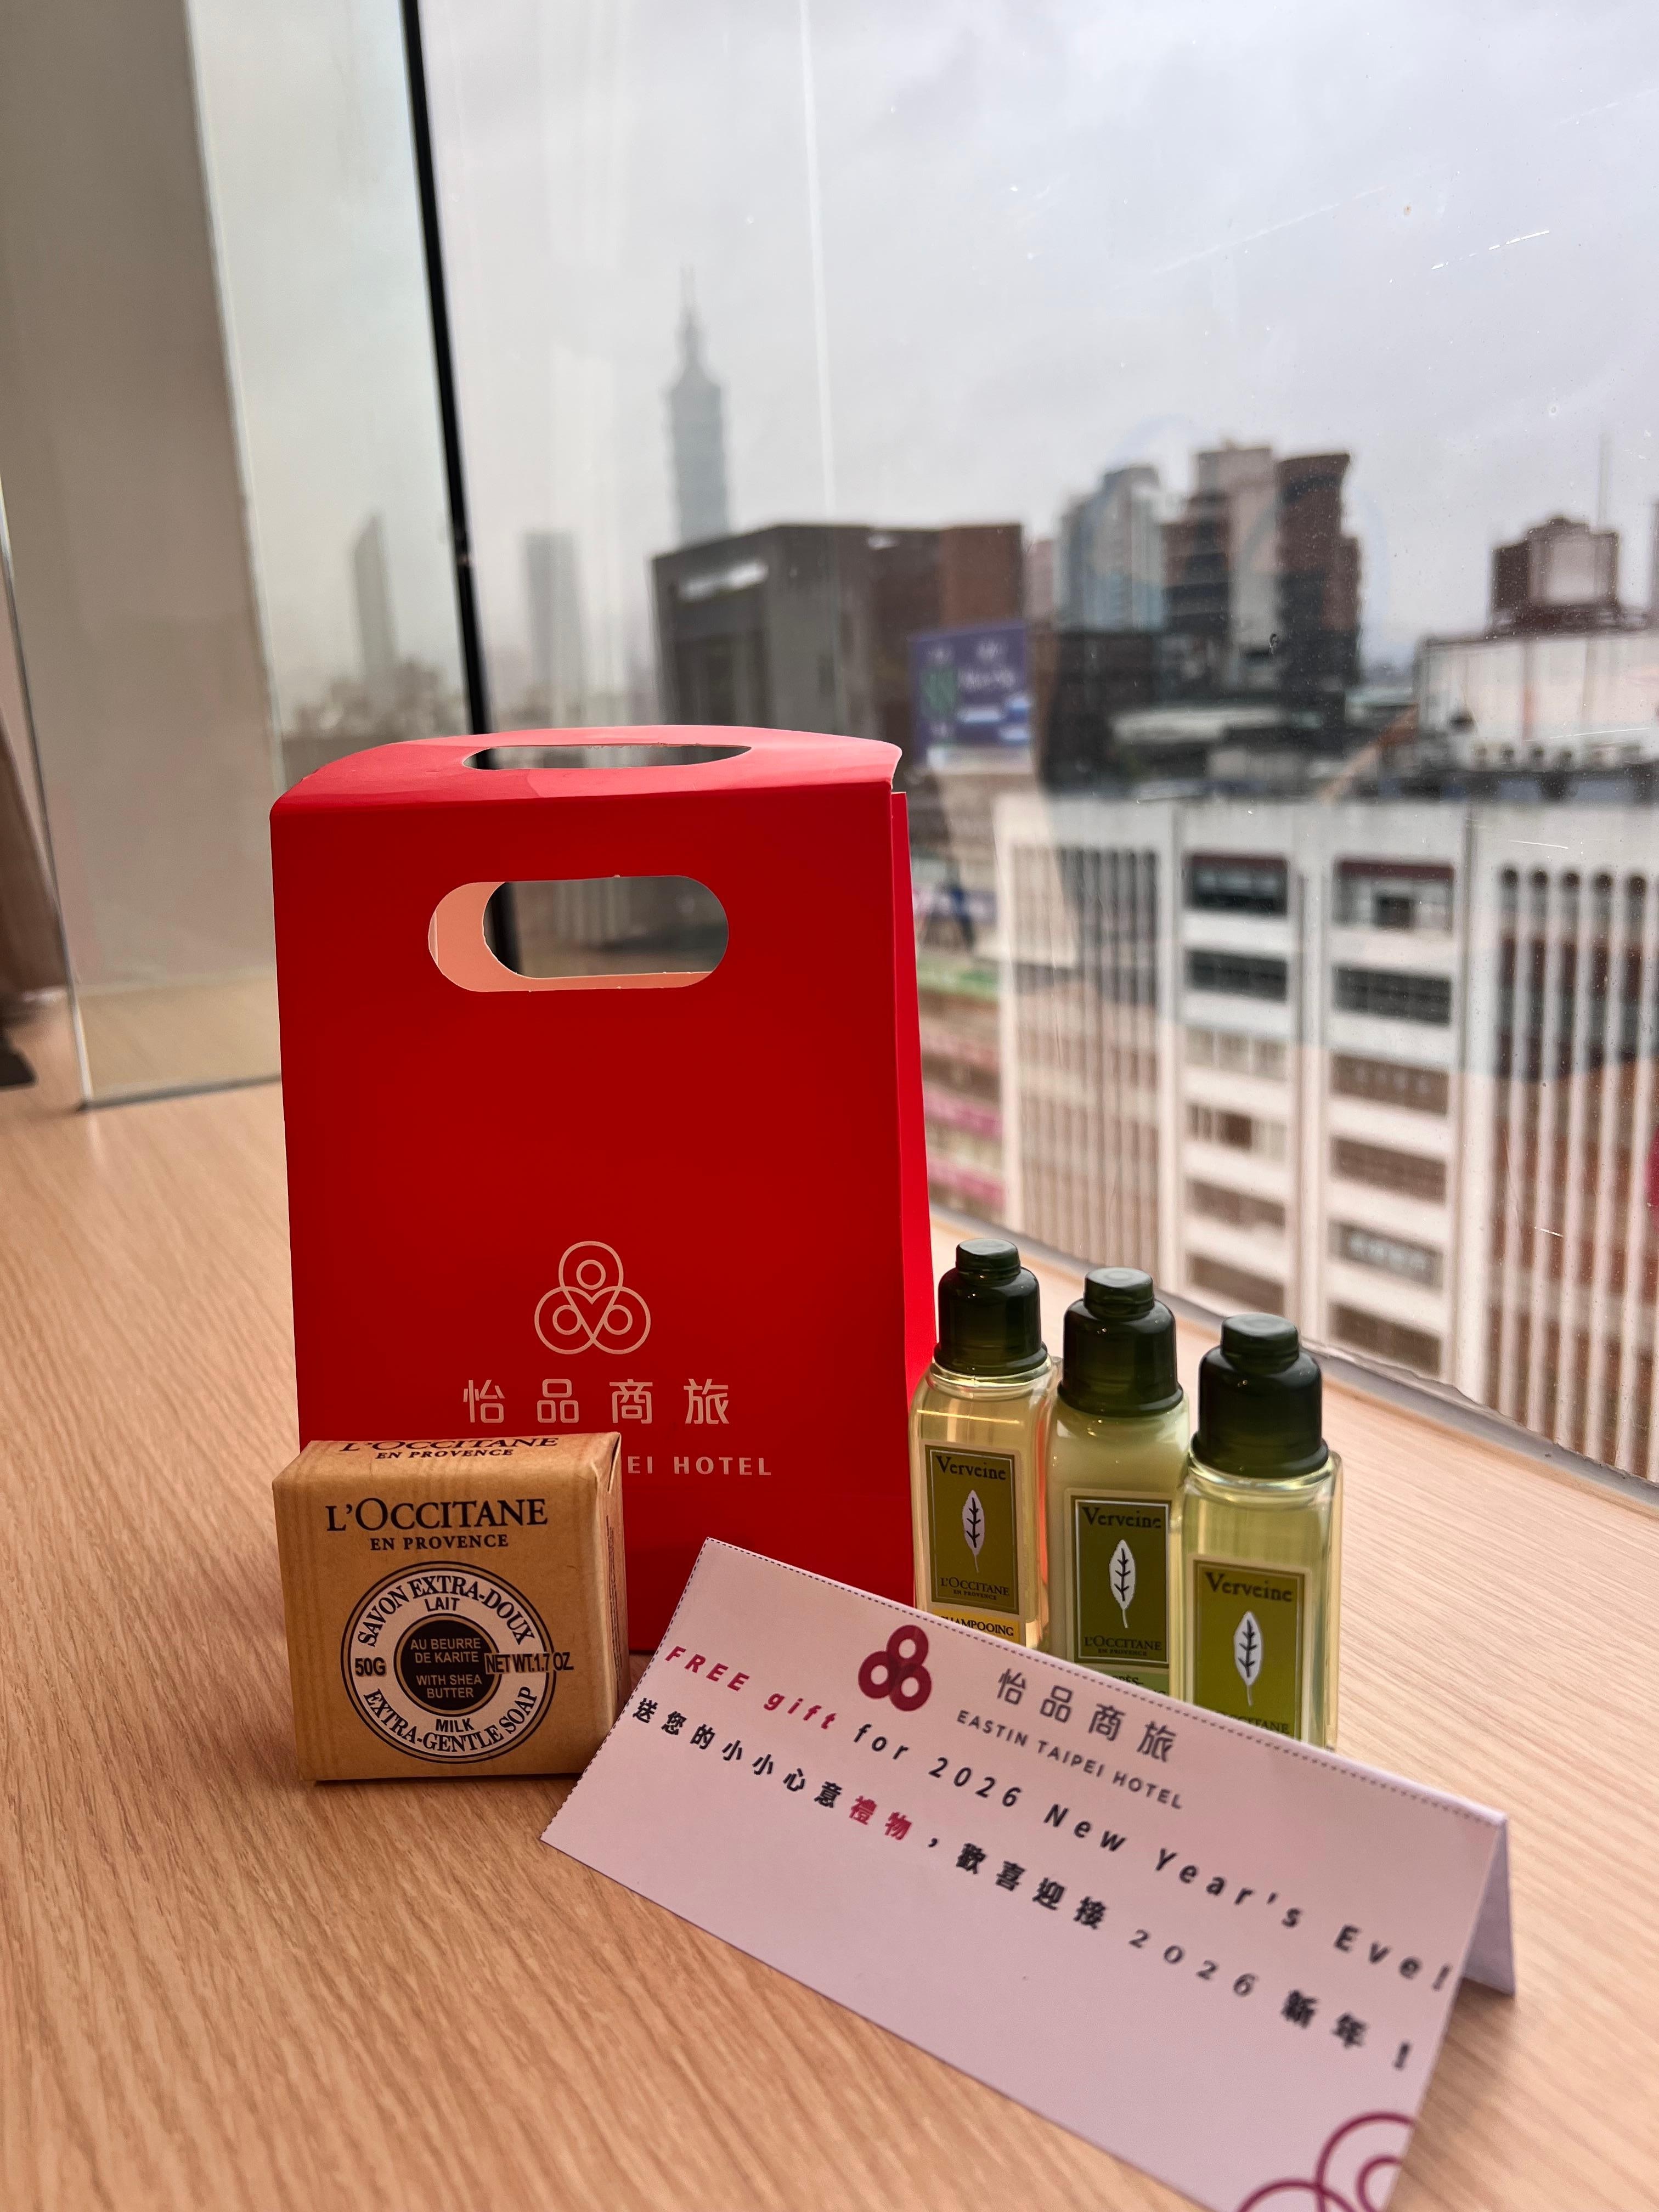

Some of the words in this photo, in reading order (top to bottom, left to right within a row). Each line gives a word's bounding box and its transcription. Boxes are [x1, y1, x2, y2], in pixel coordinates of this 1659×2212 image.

[463, 1378, 729, 1425] 怡品商旅
[408, 1449, 514, 1459] PROVENCE
[674, 1456, 771, 1476] HOTEL
[935, 1455, 1007, 1481] Verveine
[325, 1497, 548, 1532] L'OCCITANE
[1081, 1506, 1162, 1529] Verveine
[370, 1537, 395, 1551] EN
[403, 1534, 509, 1550] PROVENCE
[940, 1577, 1010, 1596] L'OCCITANE
[964, 1590, 997, 1601] PROVENCE
[1205, 1571, 1293, 1603] Verveine
[357, 1584, 410, 1647] SAVON
[407, 1575, 535, 1645] EXTRA-DOUX
[424, 1596, 461, 1612] LAIT
[410, 1639, 428, 1651] AU
[431, 1638, 481, 1650] BEURRE
[1084, 1635, 1163, 1651] L'OCCITANE
[354, 1657, 387, 1677] 50G
[415, 1652, 431, 1664] DE
[435, 1651, 479, 1663] KARITE
[486, 1654, 510, 1673] NET
[416, 1674, 447, 1686] WITH
[449, 1674, 482, 1685] SHEA
[427, 1687, 474, 1699] BUTTER
[363, 1688, 504, 1753] EXTRA-GENTLE
[500, 1686, 538, 1735] SOAP
[436, 1717, 475, 1733] MILK
[997, 1668, 1177, 1763] 怡品商旅
[956, 1709, 1029, 1747] EASTIN
[1037, 1740, 1105, 1778] TAIPEI
[1112, 1770, 1183, 1810] HOTEL
[665, 1646, 750, 1691] FREE
[763, 1693, 837, 1730] gift
[854, 1724, 909, 1760] for
[929, 1757, 1022, 1807] 2026
[1044, 1804, 1127, 1852] New
[1154, 1848, 1302, 1928] Year's
